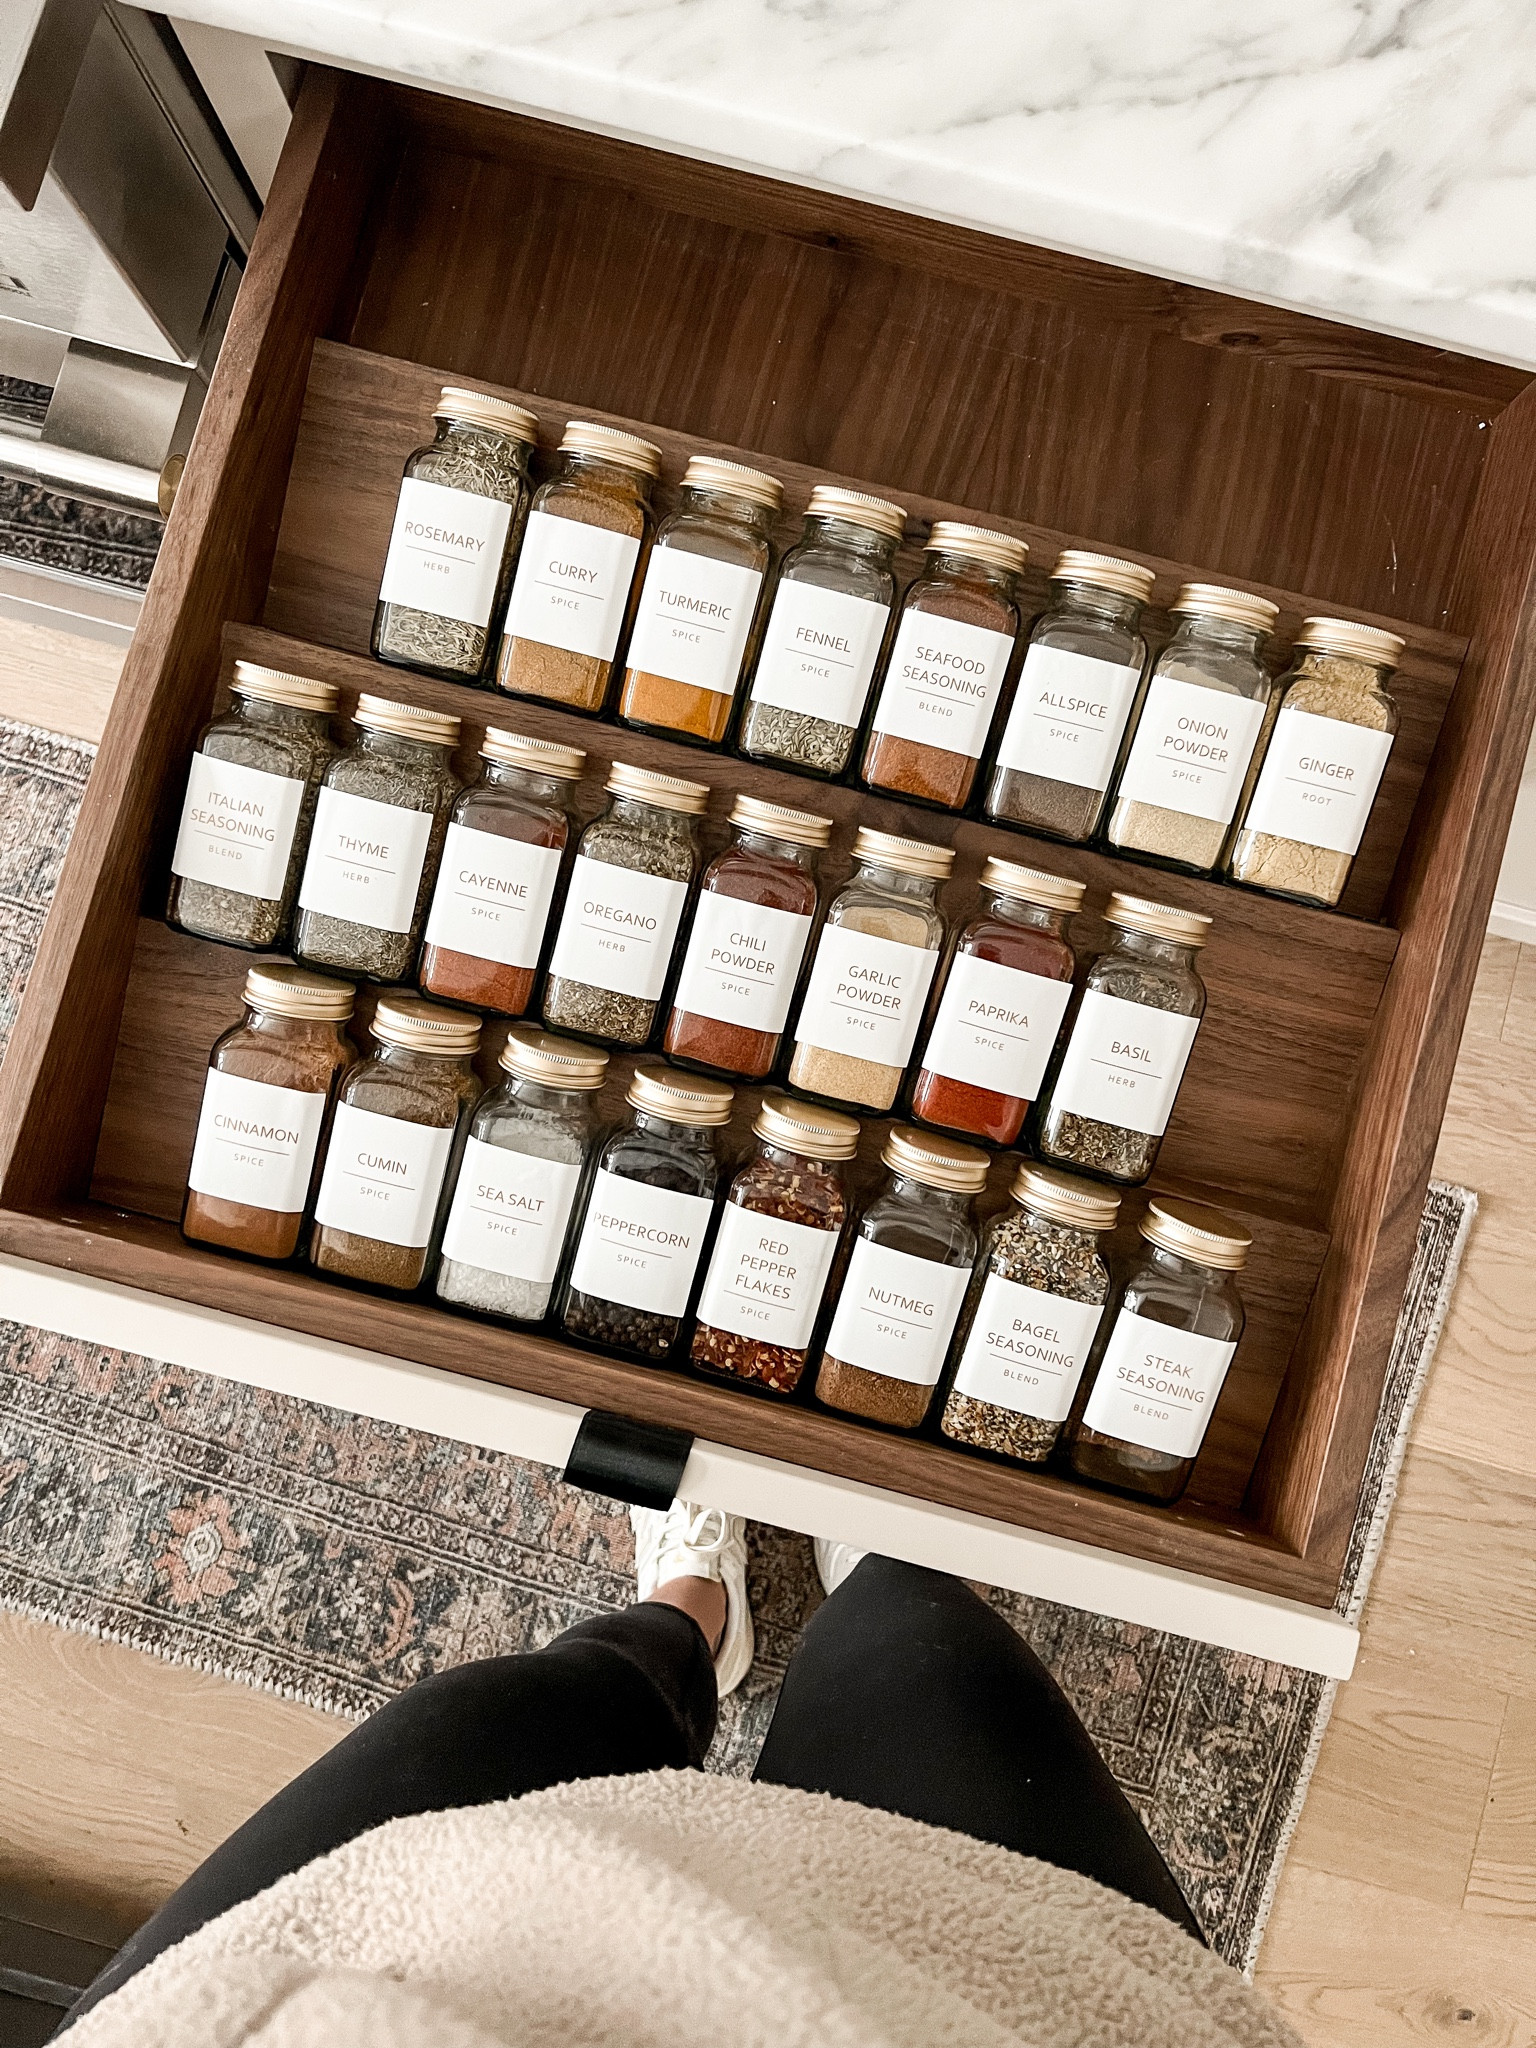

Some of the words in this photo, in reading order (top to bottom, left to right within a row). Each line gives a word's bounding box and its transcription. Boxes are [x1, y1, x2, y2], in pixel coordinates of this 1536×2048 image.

[405, 521, 486, 552] ROSEMARY
[423, 561, 450, 574] HERB
[549, 561, 598, 583] CURRY
[550, 595, 580, 610] SPICE
[660, 590, 732, 621] TURMERIC
[672, 629, 701, 644] SPICE
[796, 627, 851, 653] FENNEL
[801, 663, 830, 678] SPICE
[915, 646, 985, 675] SEAFOOD
[901, 665, 987, 697] SEASONING
[918, 701, 953, 717] BLEND
[1039, 692, 1108, 719] ALLSPICE
[1049, 728, 1079, 743] SPICE
[1177, 717, 1229, 741] ONION
[1163, 735, 1229, 763] POWDER
[1172, 769, 1202, 784] SPICE
[1299, 757, 1355, 781] GINGER
[208, 792, 264, 817] ITALIAN
[1302, 792, 1332, 806] ROOT
[189, 808, 275, 842] SEASONING
[208, 844, 242, 860] BLEND
[339, 835, 390, 859] THYME
[342, 871, 370, 884] HERB
[459, 870, 528, 898] CAYENNE
[471, 907, 501, 922] SPICE
[583, 901, 657, 931] OREGANO
[598, 939, 626, 952] HERB
[730, 932, 767, 952] CHILI
[711, 948, 775, 975] POWDER
[848, 965, 902, 989] GARLIC
[721, 982, 751, 996] SPICE
[837, 983, 901, 1010] POWDER
[846, 1016, 876, 1031] SPICE
[968, 1000, 1029, 1028] PAPRIKA
[974, 1036, 1005, 1051] SPICE
[1111, 1041, 1151, 1063] BASIL
[1108, 1074, 1136, 1088] HERB
[214, 1114, 299, 1144] CINNAMON
[234, 1153, 264, 1167] SPICE
[357, 1153, 407, 1175] CUMIN
[360, 1186, 390, 1201] SPICE
[476, 1185, 504, 1203] SEA
[507, 1193, 545, 1212] SALT
[487, 1221, 518, 1236] SPICE
[593, 1212, 690, 1249] PEPPERCORN
[758, 1237, 789, 1256] RED
[617, 1254, 647, 1269] SPICE
[740, 1254, 797, 1280] PEPPER
[735, 1274, 791, 1300] FLAKES
[868, 1286, 934, 1317] NUTMEG
[740, 1306, 771, 1321] SPICE
[876, 1324, 908, 1340] SPICE
[1012, 1318, 1060, 1344] BAGEL
[985, 1331, 1075, 1367] SEASONING
[1003, 1369, 1039, 1386] BLEND
[1143, 1354, 1194, 1379] STEAK
[1116, 1367, 1206, 1403] SEASONING
[1133, 1404, 1169, 1421] BLEND
